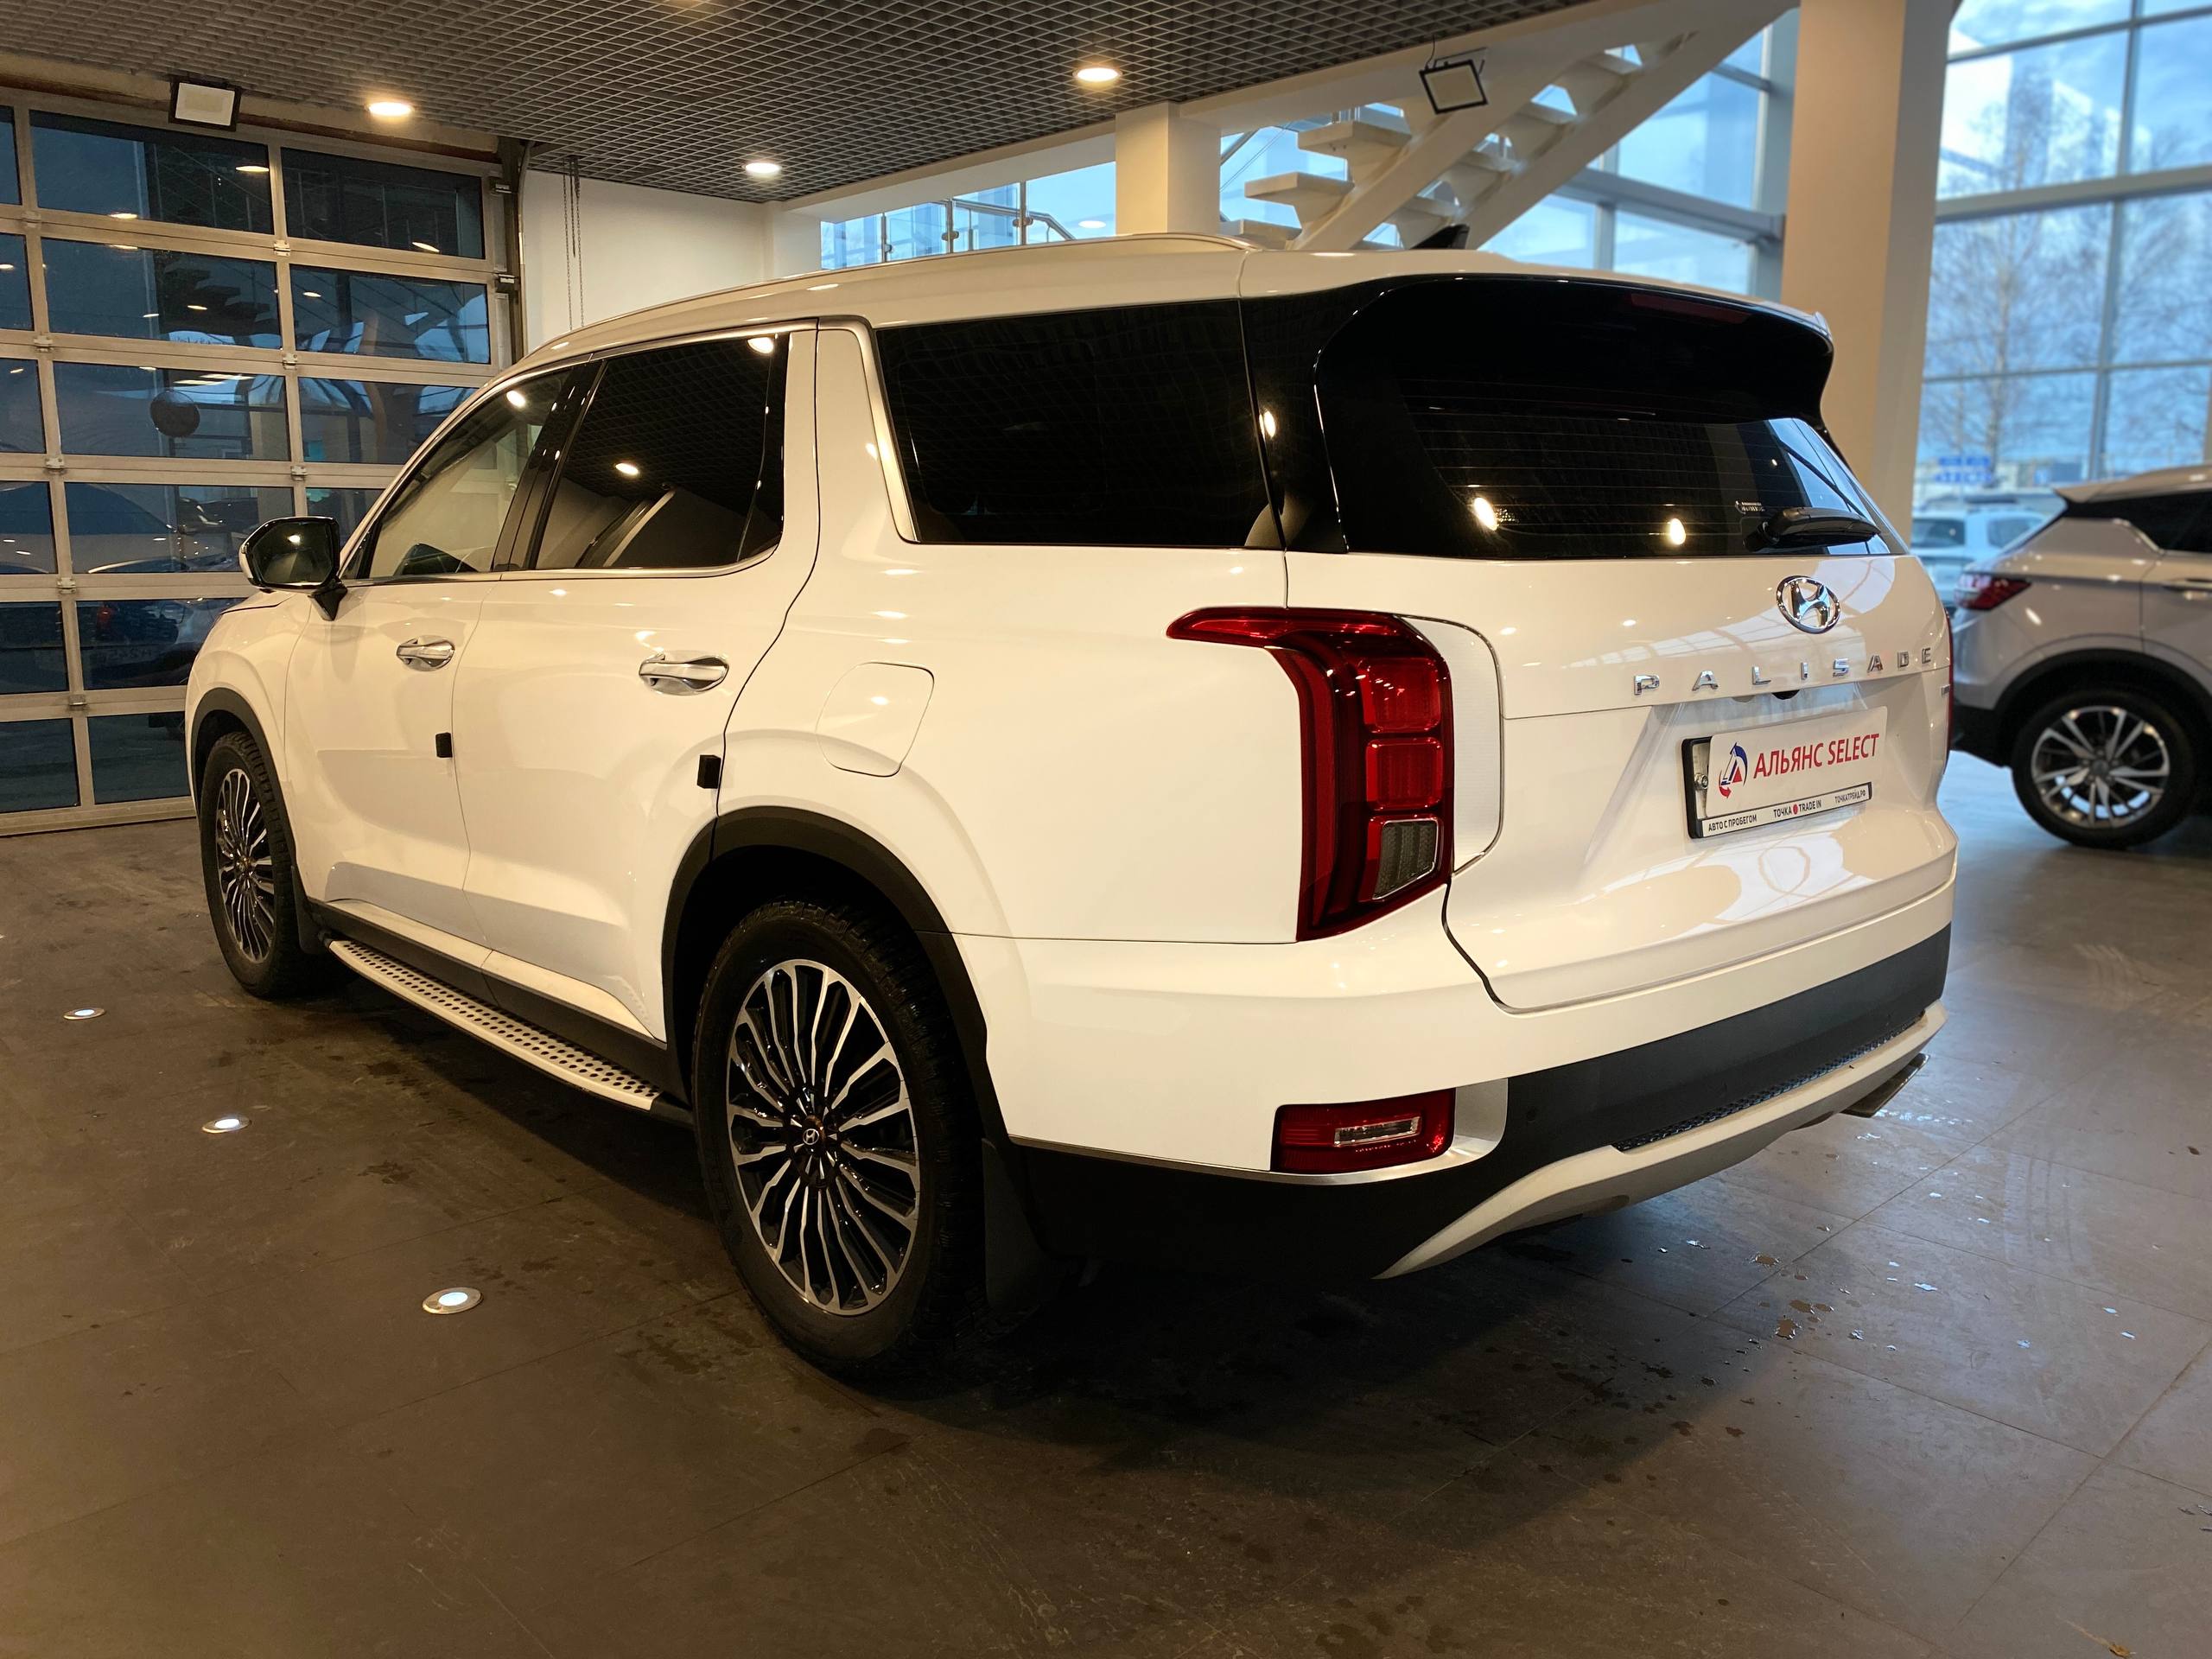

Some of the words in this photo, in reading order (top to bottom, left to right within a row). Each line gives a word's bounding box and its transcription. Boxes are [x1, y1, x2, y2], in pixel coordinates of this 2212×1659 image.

[1633, 647, 1932, 696] PALISADE
[1753, 742, 1824, 779] АЛЬЯНС
[1827, 733, 1880, 766] SELECT
[1708, 823, 1724, 831] АВТО
[1728, 814, 1758, 828] ПРОБЕГОМ
[1773, 806, 1792, 817] ТОЧКА
[1799, 801, 1815, 812] TRADE
[1815, 799, 1822, 809] IN
